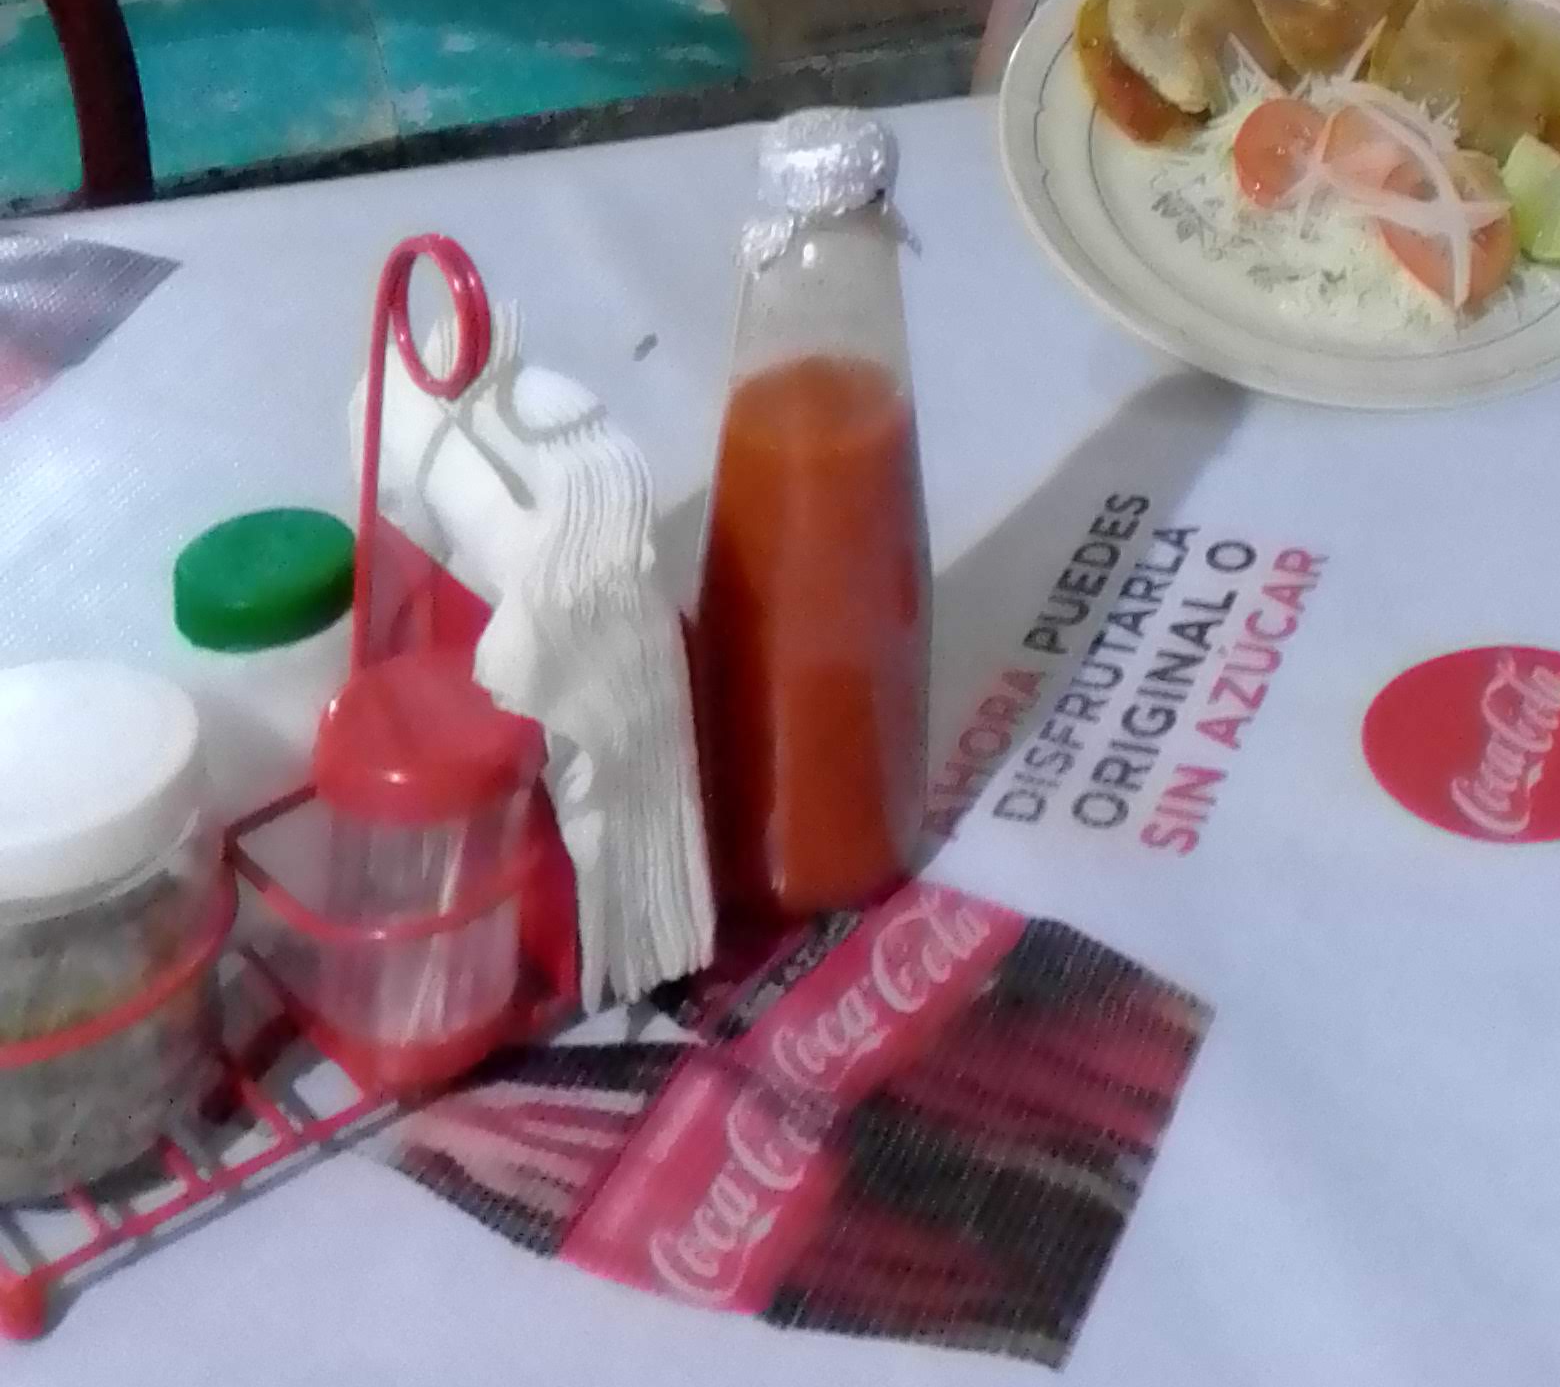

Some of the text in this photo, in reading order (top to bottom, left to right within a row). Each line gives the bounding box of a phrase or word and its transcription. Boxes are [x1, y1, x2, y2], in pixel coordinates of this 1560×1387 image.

[992, 525, 1202, 824] DISFRUTARLA
[1021, 492, 1150, 655] PUEDES
[1072, 539, 1258, 829] ORIGINAL O
[1139, 545, 1330, 856] SIN AZÚCAR
